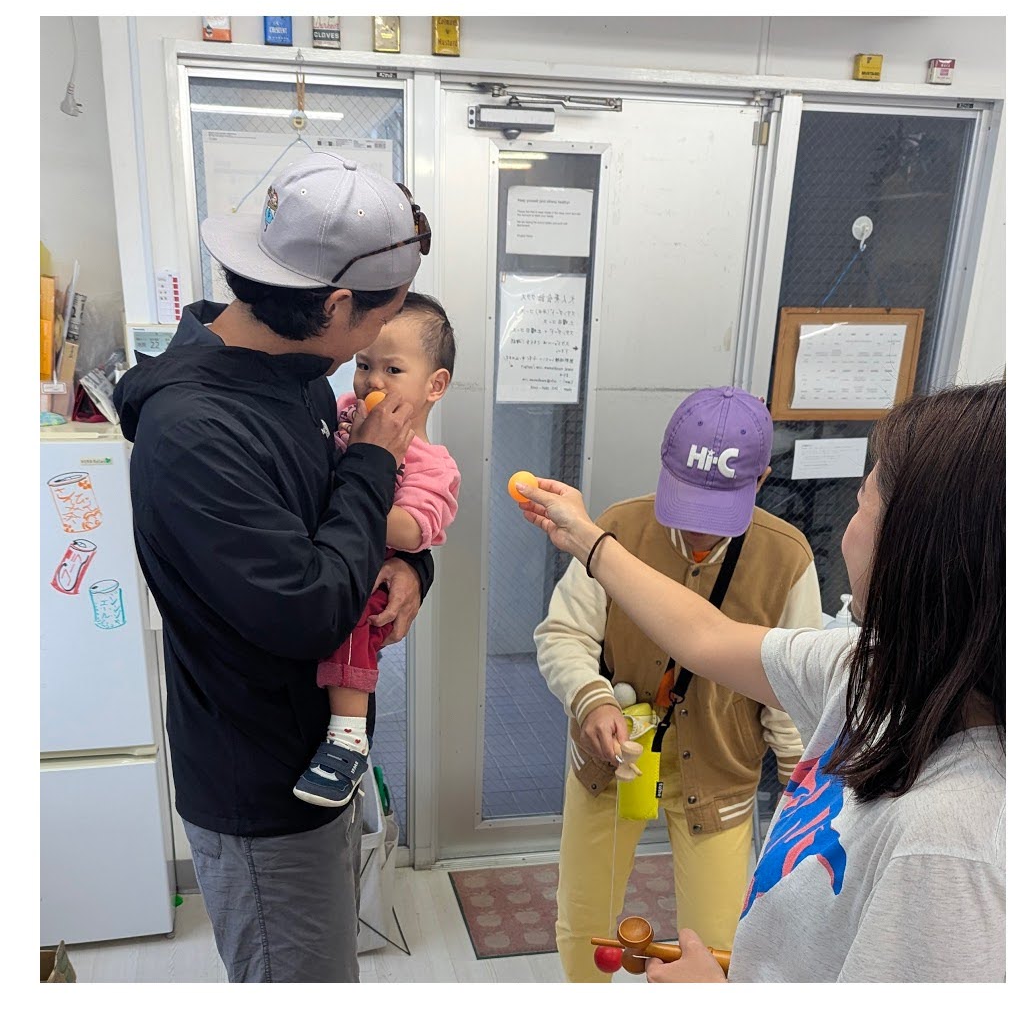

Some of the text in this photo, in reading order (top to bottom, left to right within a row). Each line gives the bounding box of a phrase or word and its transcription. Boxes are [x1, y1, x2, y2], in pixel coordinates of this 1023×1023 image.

[313, 31, 339, 39] CLOVES
[150, 341, 160, 349] 22
[686, 444, 740, 479] Hi-C
